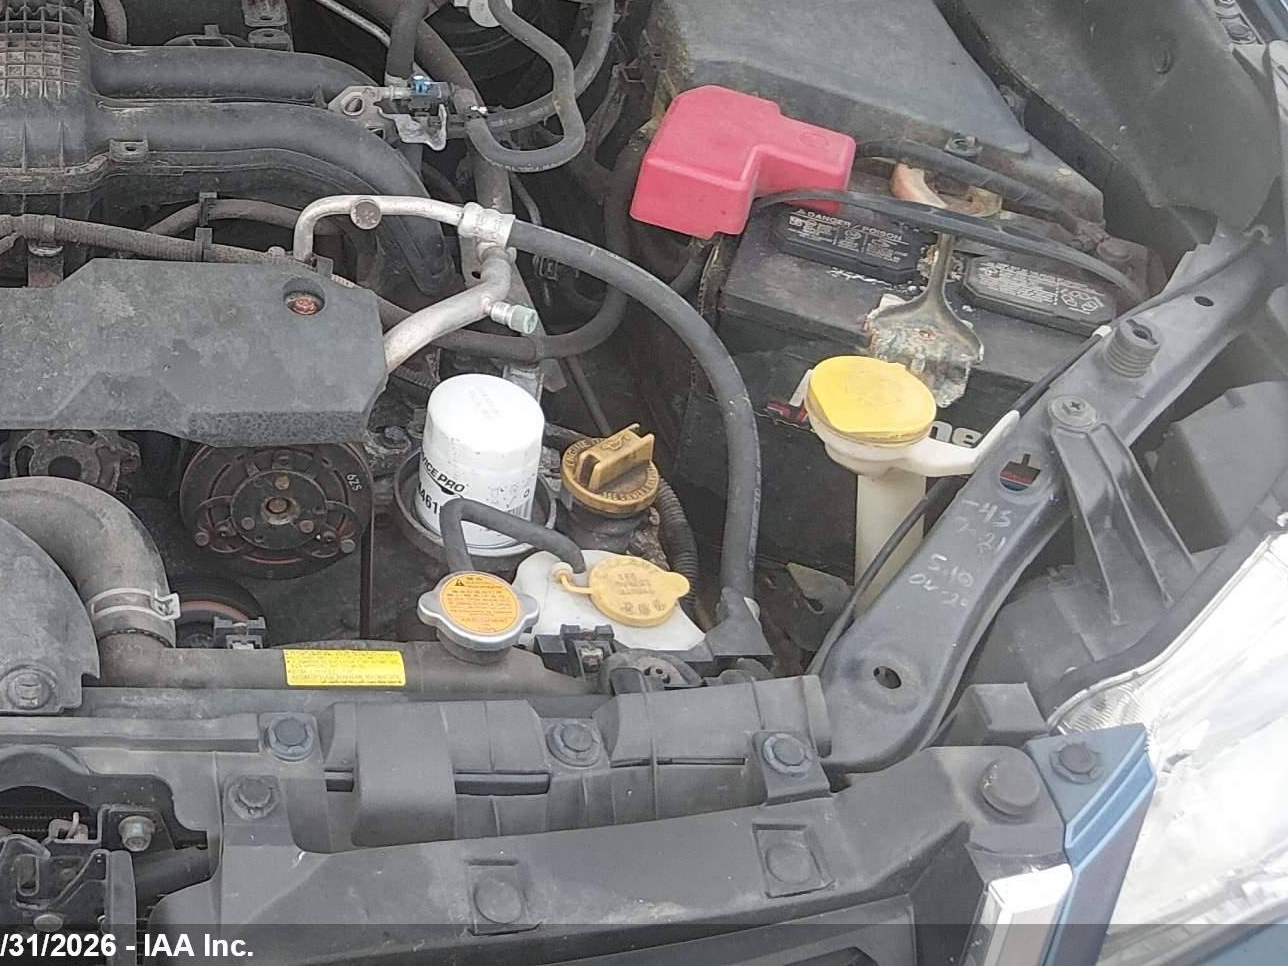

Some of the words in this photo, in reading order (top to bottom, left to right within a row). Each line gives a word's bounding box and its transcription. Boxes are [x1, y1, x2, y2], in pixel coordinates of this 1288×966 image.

[807, 211, 852, 228] DANGER
[862, 225, 904, 241] POISON
[437, 472, 466, 493] PRO
